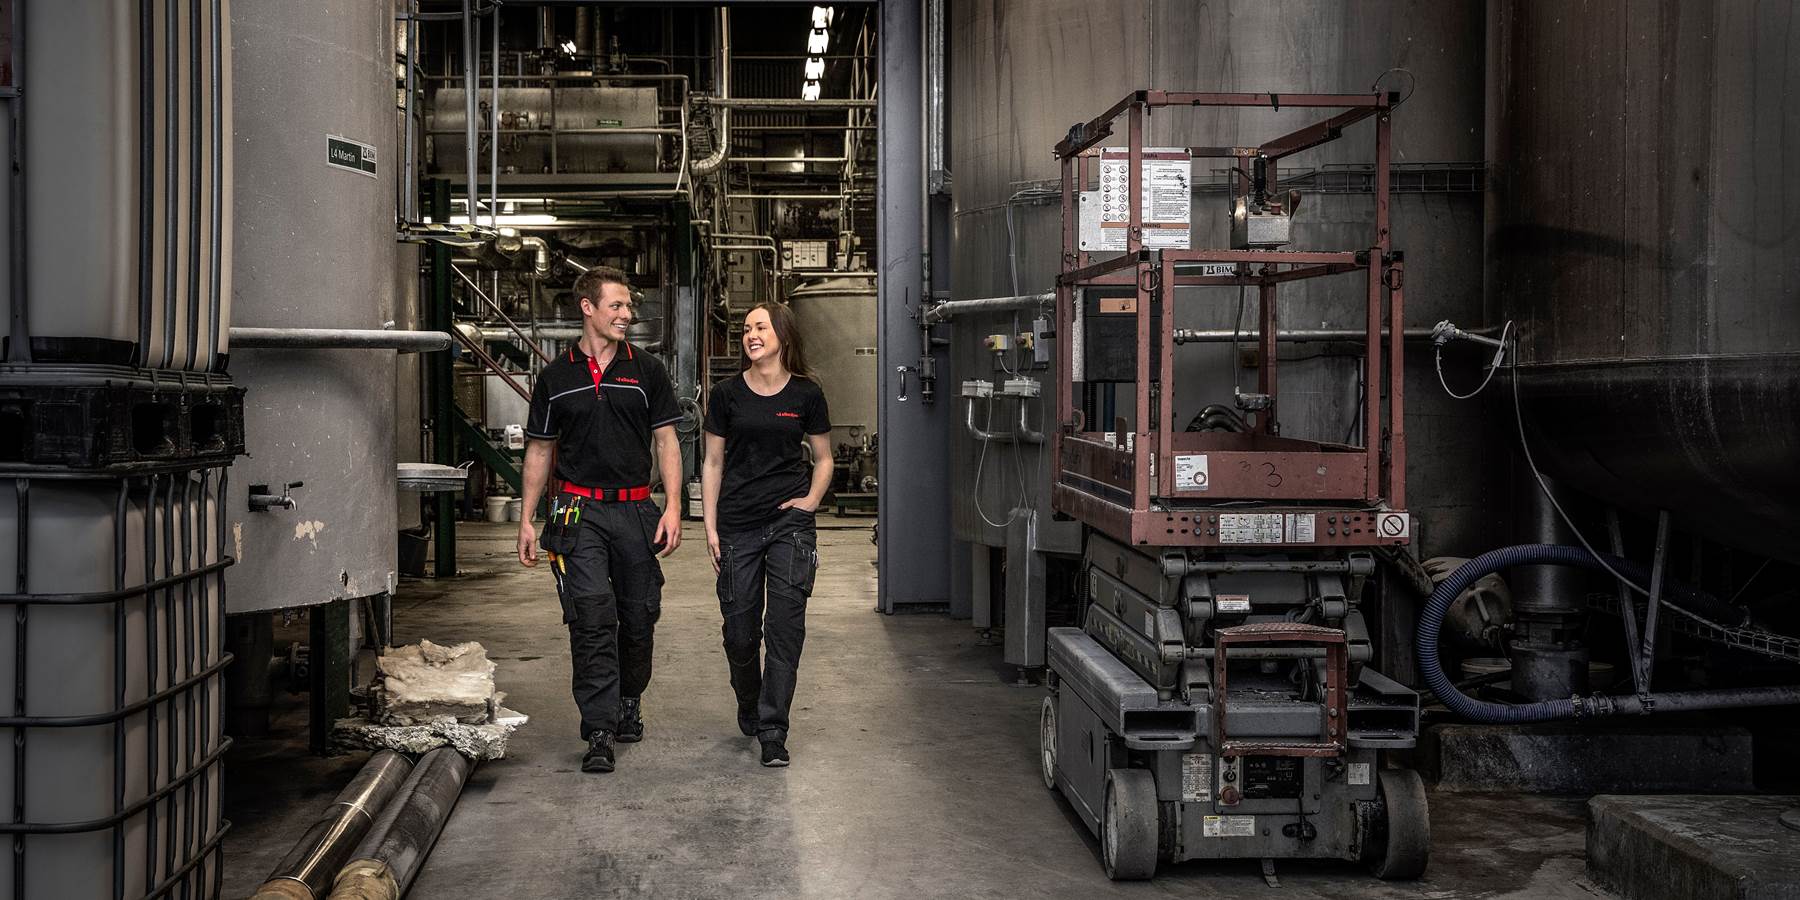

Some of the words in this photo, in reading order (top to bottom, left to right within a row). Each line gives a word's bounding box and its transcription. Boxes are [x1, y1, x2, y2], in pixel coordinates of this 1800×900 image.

[331, 148, 338, 158] L4
[339, 150, 356, 163] Martin
[1262, 462, 1283, 488] 3
